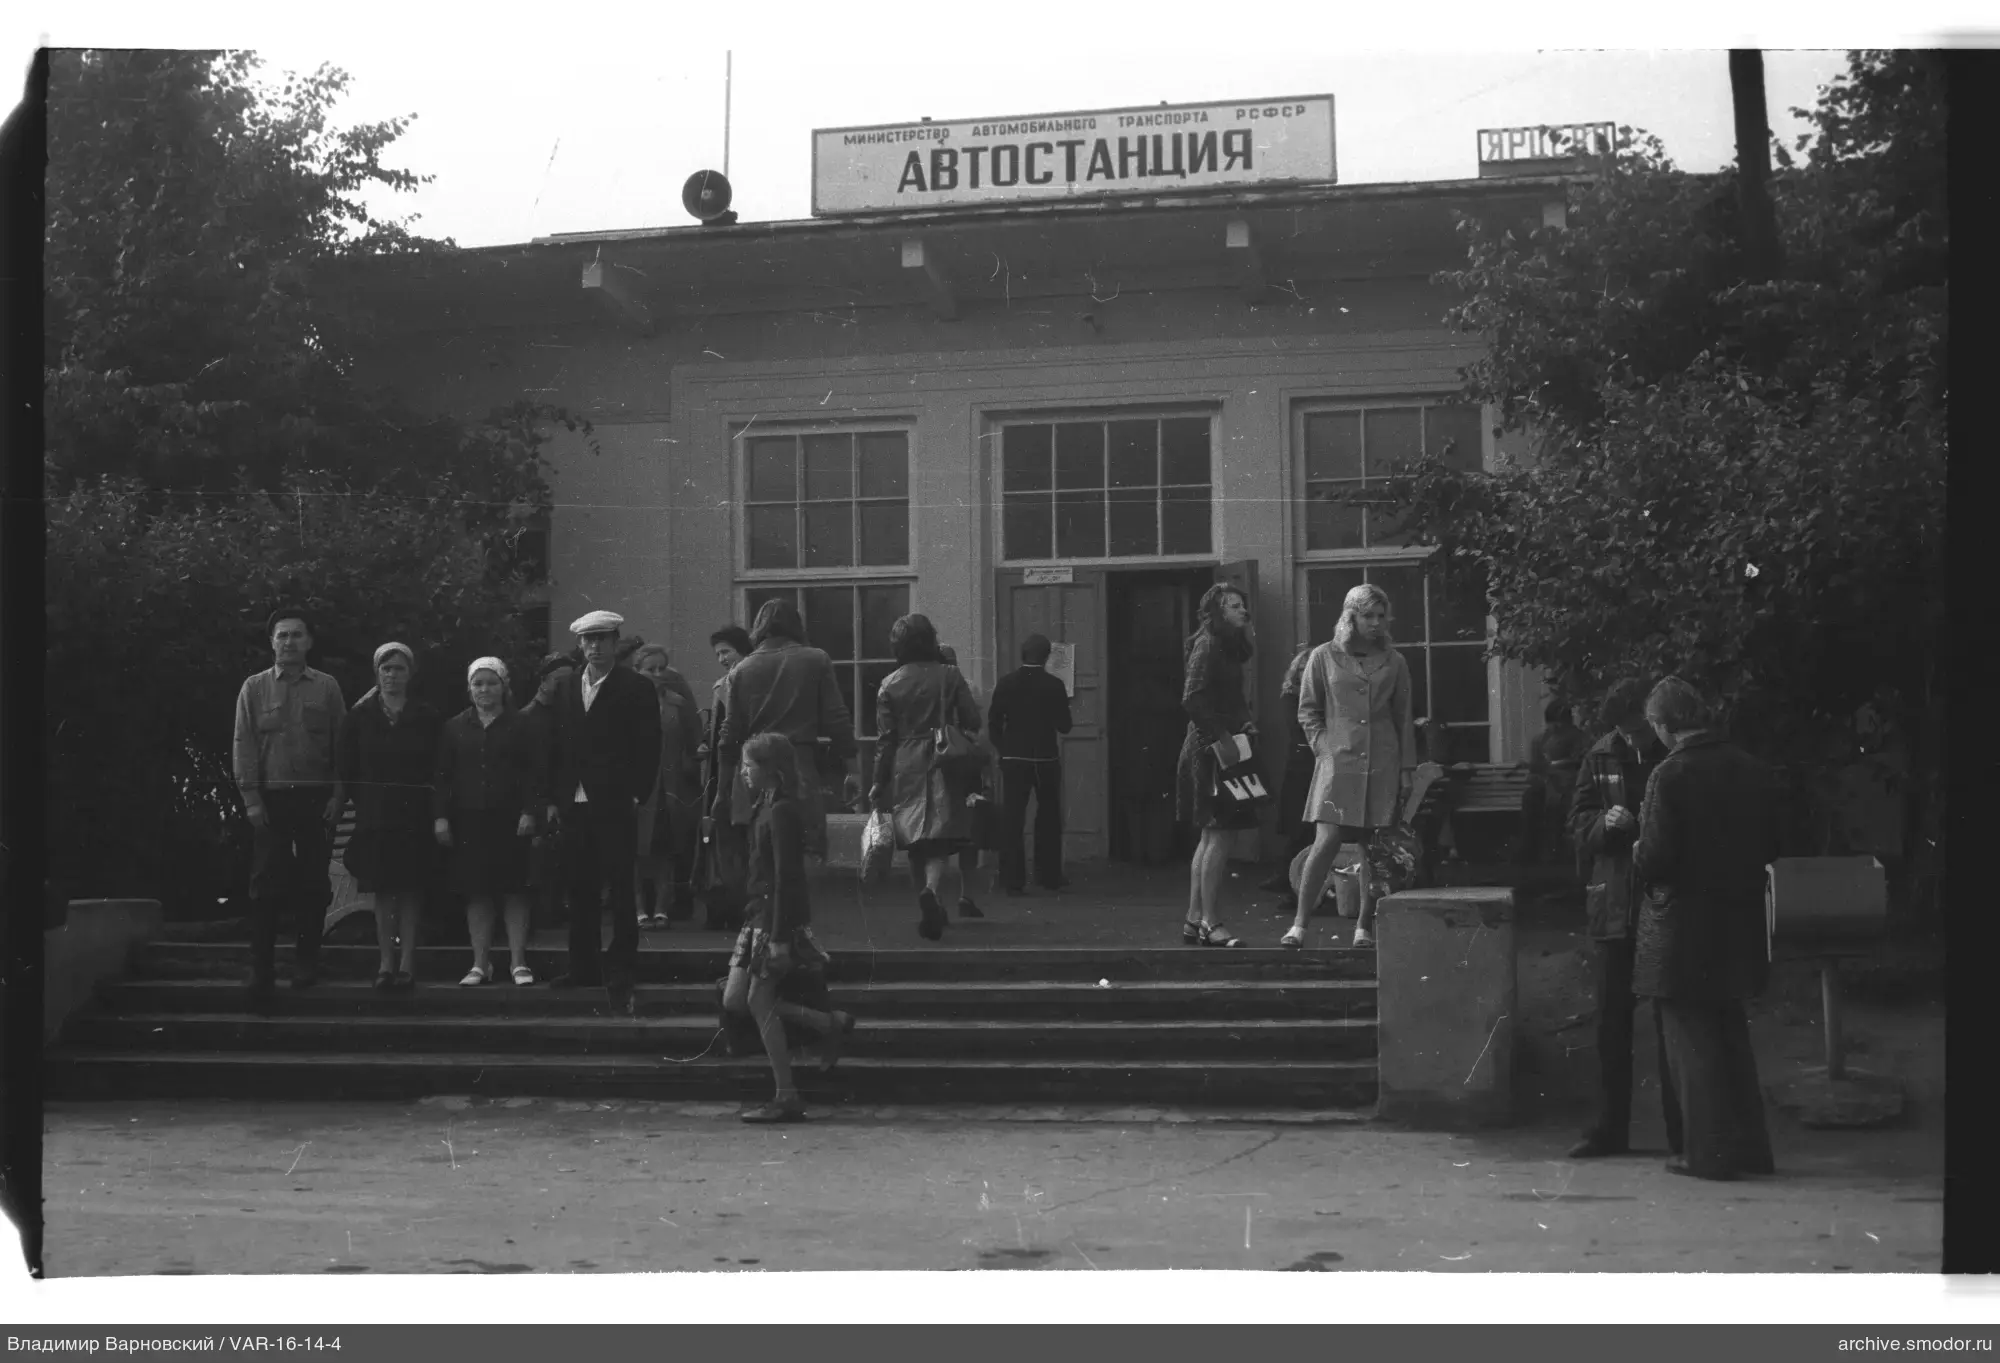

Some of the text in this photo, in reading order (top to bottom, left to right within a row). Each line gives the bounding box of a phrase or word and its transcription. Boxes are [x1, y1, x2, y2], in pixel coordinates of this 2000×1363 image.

[844, 105, 1306, 145] МИНИСТЕРСТВО АВТОМОБИЛЬНОГО ТРАНСПОРТА РСФСР
[897, 128, 1253, 193] АВТОСТАНЦИЯ
